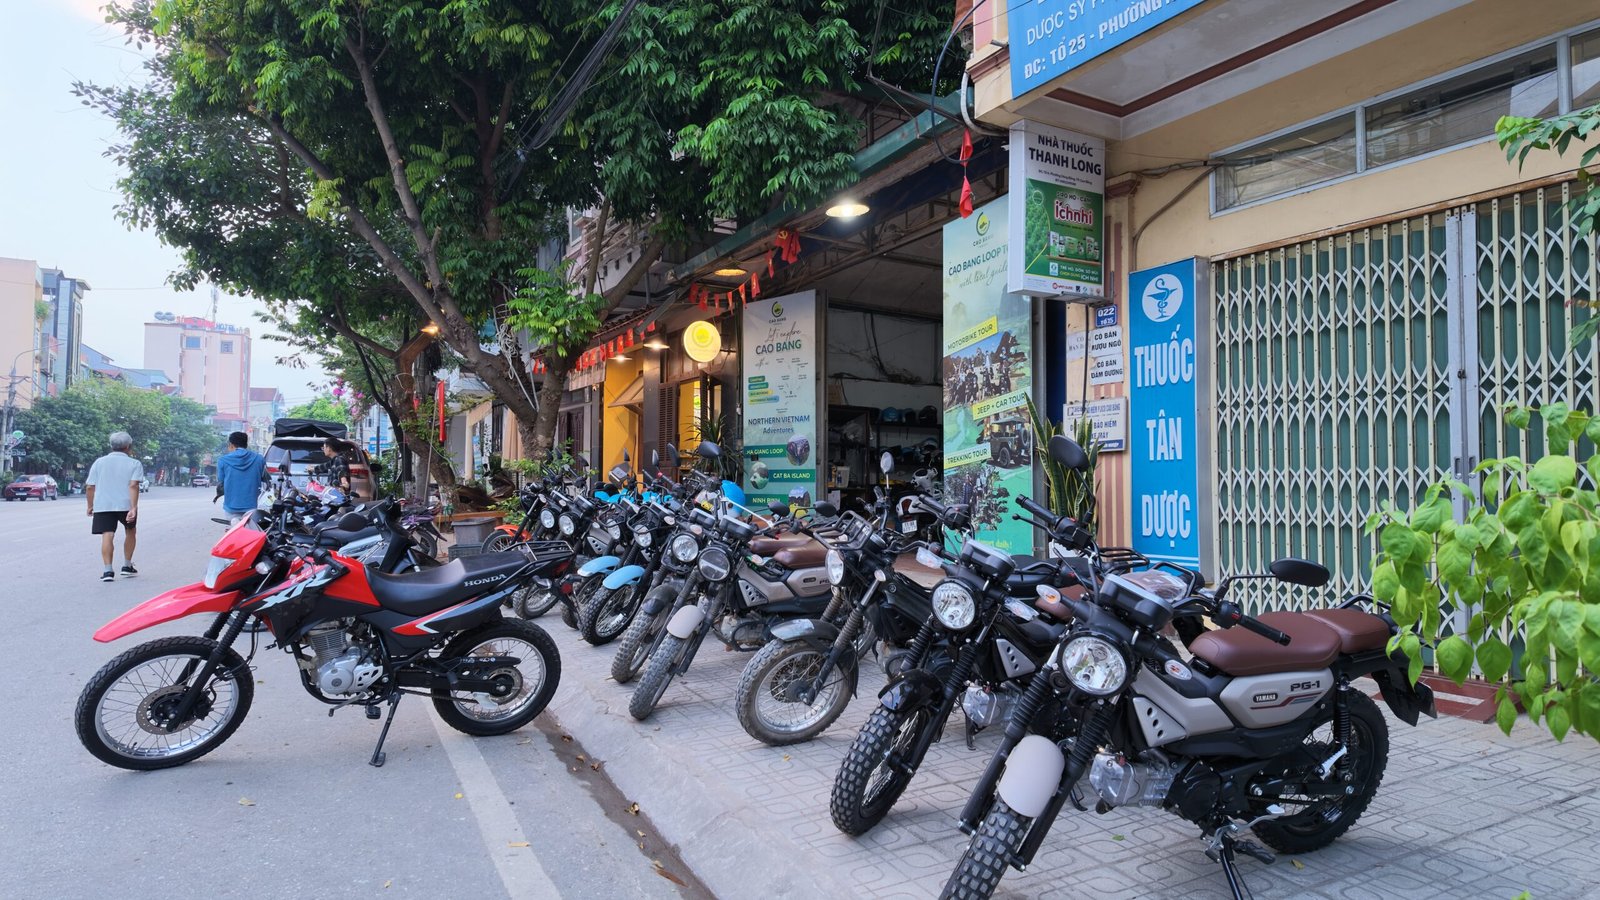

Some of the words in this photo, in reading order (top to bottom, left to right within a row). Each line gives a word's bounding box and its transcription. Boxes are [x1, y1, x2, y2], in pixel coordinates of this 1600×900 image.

[1027, 10, 1064, 45] DƯỢC
[1068, 34, 1087, 56] 25
[1098, 0, 1162, 40] PHƯỜNG
[1038, 134, 1059, 149] NHÀ
[1060, 140, 1093, 157] THUỐC
[1029, 147, 1069, 168] THANH
[1071, 157, 1102, 176] LONG
[948, 263, 962, 276] CAO
[962, 255, 981, 271] BANG
[982, 247, 1002, 263] LOOP
[1097, 307, 1115, 317] 022
[755, 343, 774, 355] CAO
[776, 339, 802, 352] BANG
[947, 331, 977, 350] MOTORBIKE
[978, 323, 993, 336] TOUR
[1134, 323, 1193, 388] THUỐC
[977, 404, 991, 415] JEEP
[995, 399, 1008, 408] CAR
[1008, 392, 1025, 404] TOUR
[748, 416, 781, 426] NORTHERN
[781, 414, 810, 424] VIETNAM
[763, 426, 794, 434] Adventures
[1146, 409, 1182, 461] TÂN
[947, 452, 972, 464] TREKKING
[972, 447, 988, 458] TOUR
[1142, 490, 1191, 548] DƯỢC
[464, 573, 507, 587] HONDA
[1290, 680, 1320, 691] PG-1
[1255, 694, 1276, 702] YAMAHA
